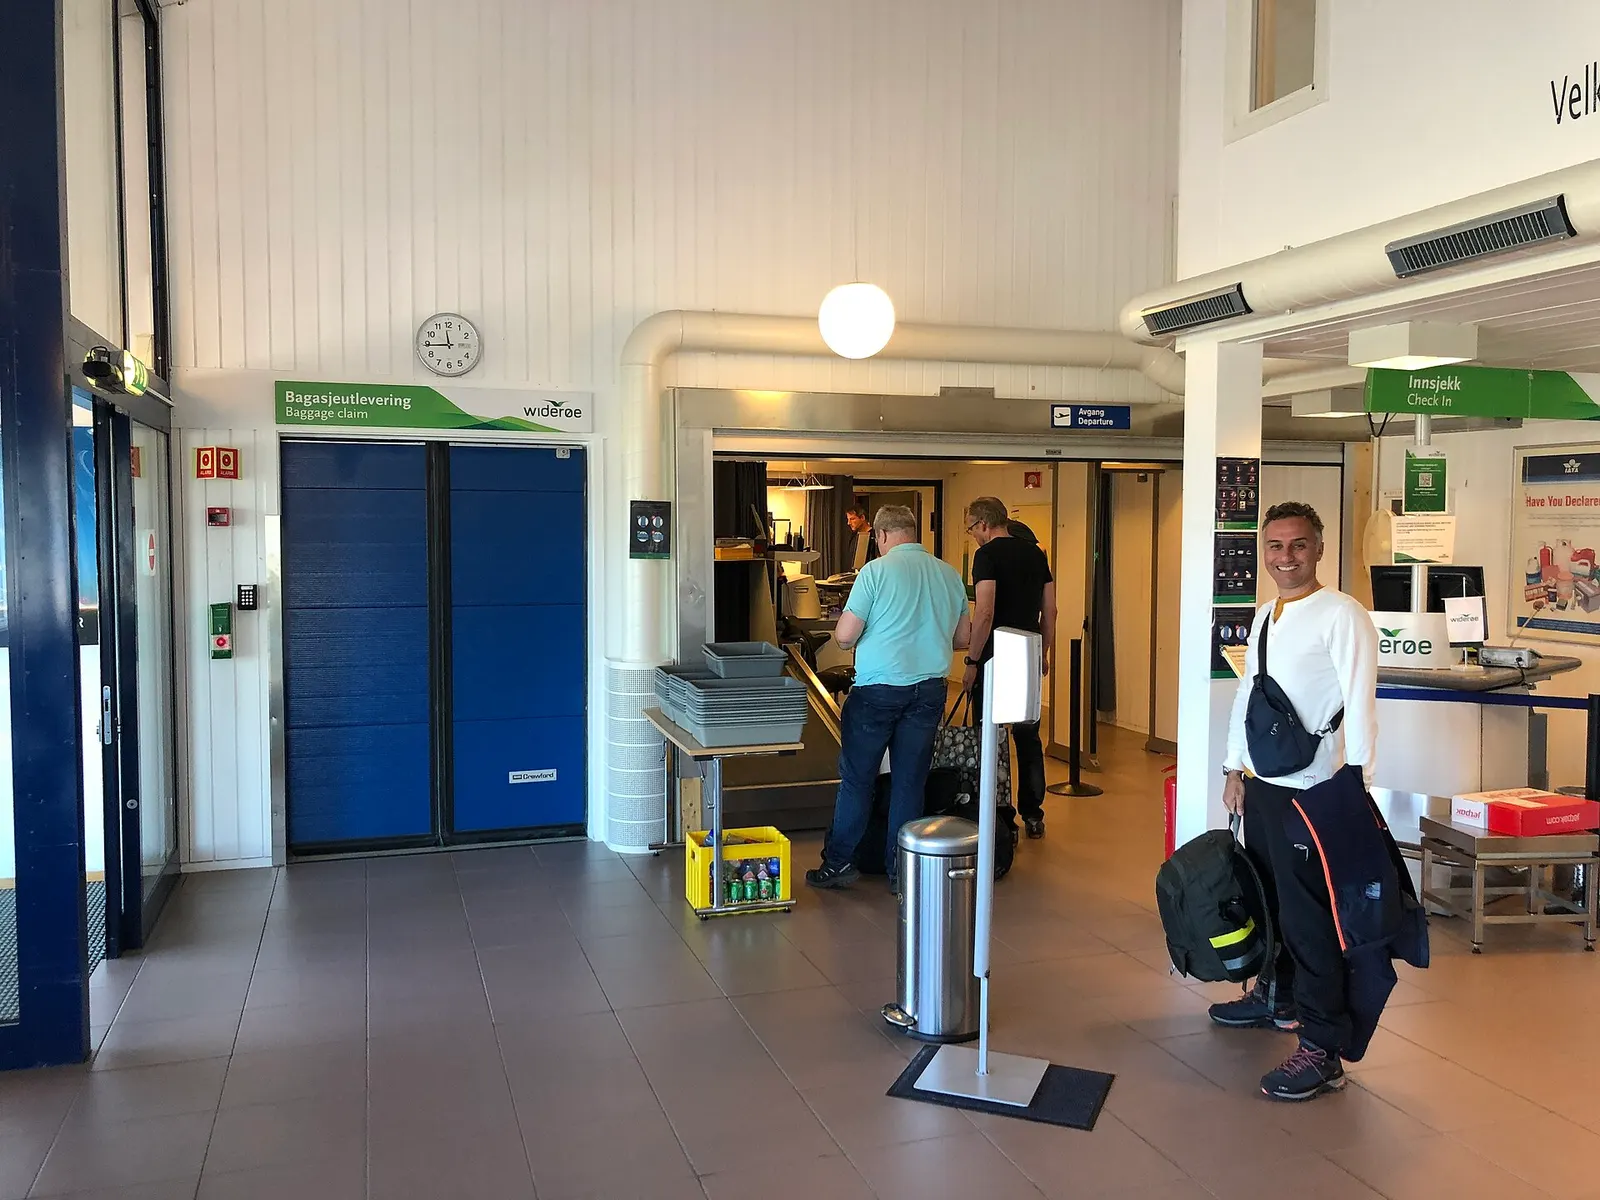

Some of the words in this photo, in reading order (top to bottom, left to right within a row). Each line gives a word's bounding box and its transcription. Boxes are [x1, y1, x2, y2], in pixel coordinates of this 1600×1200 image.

[1409, 375, 1461, 393] Innsjekk
[285, 391, 411, 409] Bagasjeutlevering
[1407, 393, 1438, 406] Check
[1441, 395, 1452, 407] In
[285, 406, 335, 421] Baggage
[337, 408, 368, 419] claim
[523, 404, 582, 418] widerøe
[1078, 408, 1105, 417] Avgang
[1078, 417, 1114, 426] Departure
[1526, 496, 1545, 507] Have
[1548, 496, 1563, 507] You
[1565, 495, 1600, 507] Declare
[1379, 639, 1432, 655] erøe
[1456, 808, 1482, 819] jetpak
